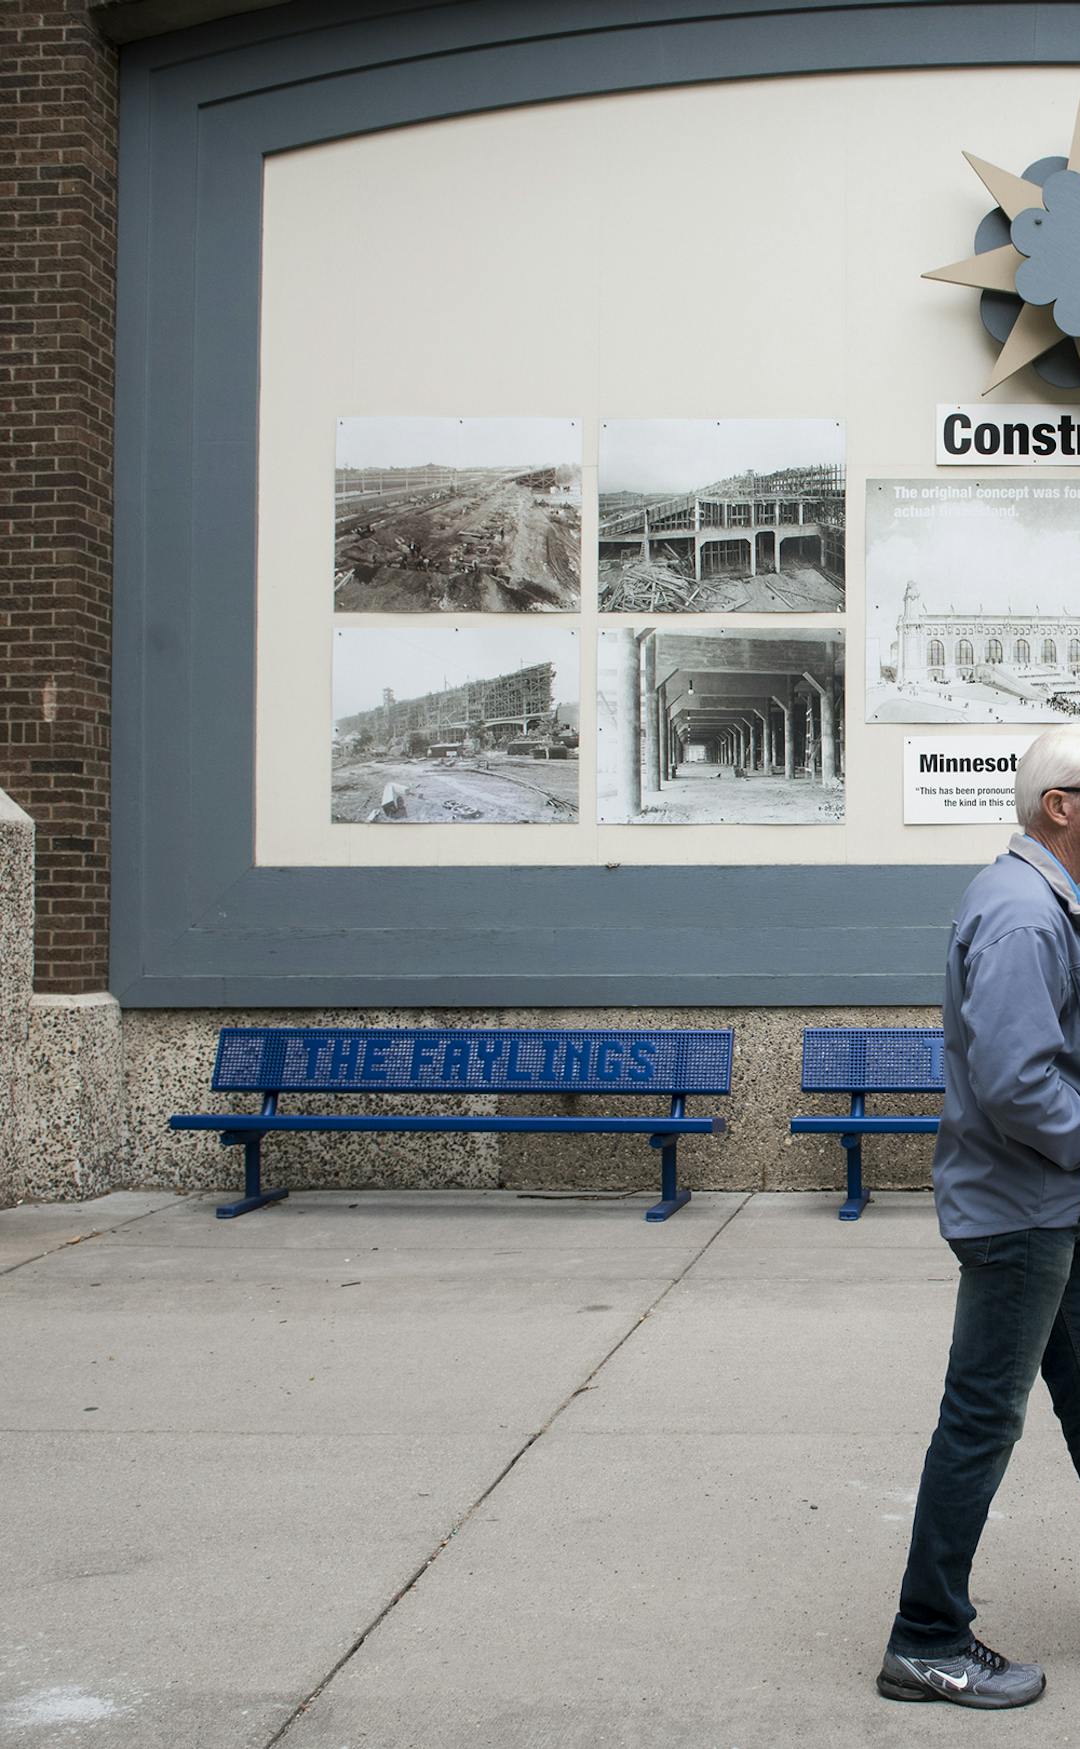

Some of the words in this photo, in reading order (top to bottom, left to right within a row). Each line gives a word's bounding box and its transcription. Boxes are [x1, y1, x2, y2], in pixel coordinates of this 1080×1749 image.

[894, 486, 918, 499] The
[921, 486, 972, 501] original
[976, 486, 1029, 500] concept
[1033, 488, 1060, 499] was
[894, 505, 935, 518] actual
[919, 753, 1018, 773] Minnesot
[939, 787, 954, 795] has
[955, 787, 976, 795] been
[977, 787, 1016, 796] pronounc
[944, 799, 957, 807] the
[959, 799, 977, 807] kind
[979, 799, 987, 807] in
[989, 799, 1004, 807] this
[301, 1039, 393, 1081] THE
[410, 1039, 657, 1082] FAYLINGS
